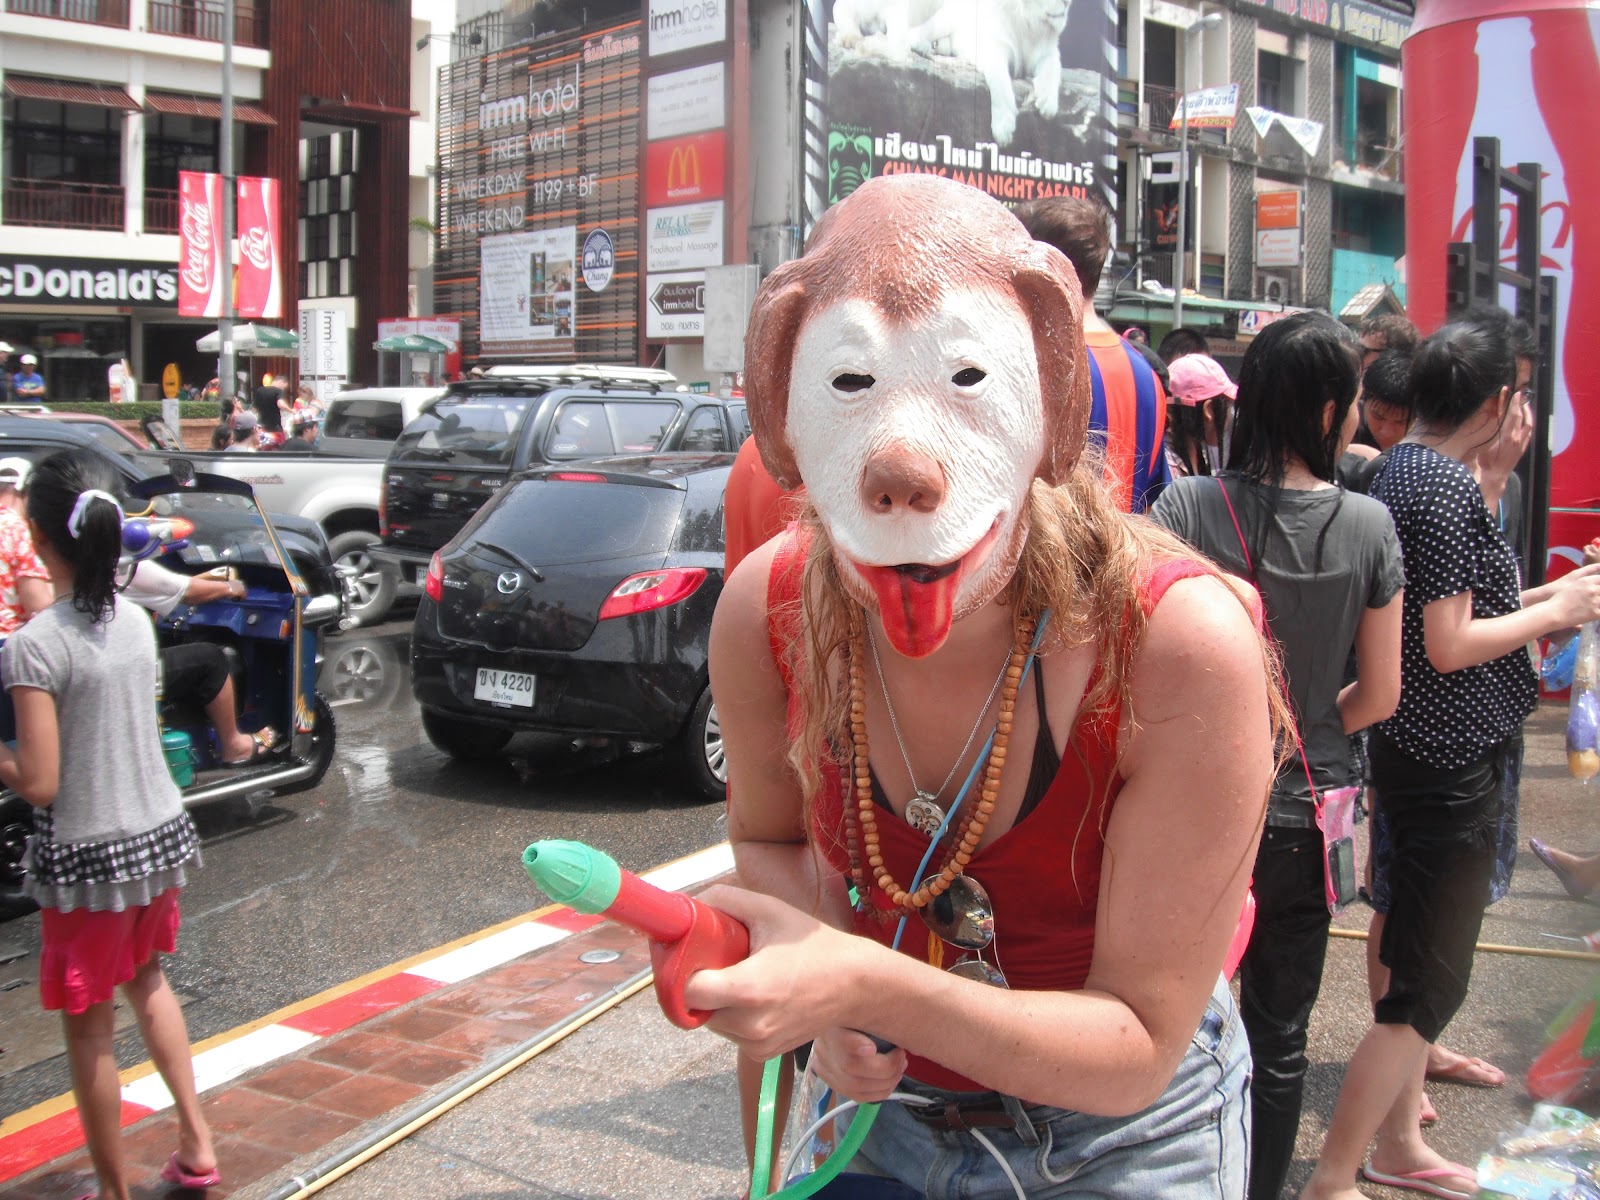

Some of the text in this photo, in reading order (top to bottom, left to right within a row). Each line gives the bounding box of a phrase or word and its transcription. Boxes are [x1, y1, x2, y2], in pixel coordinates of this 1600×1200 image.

[491, 135, 526, 162] FREE
[456, 171, 522, 200] WEEKDAY
[534, 178, 563, 203] 1199
[579, 173, 597, 197] BF
[987, 173, 1034, 200] NIGHT
[1036, 180, 1088, 200] SAFARI
[455, 206, 524, 233] WEEKEND
[501, 673, 532, 693] 4220
